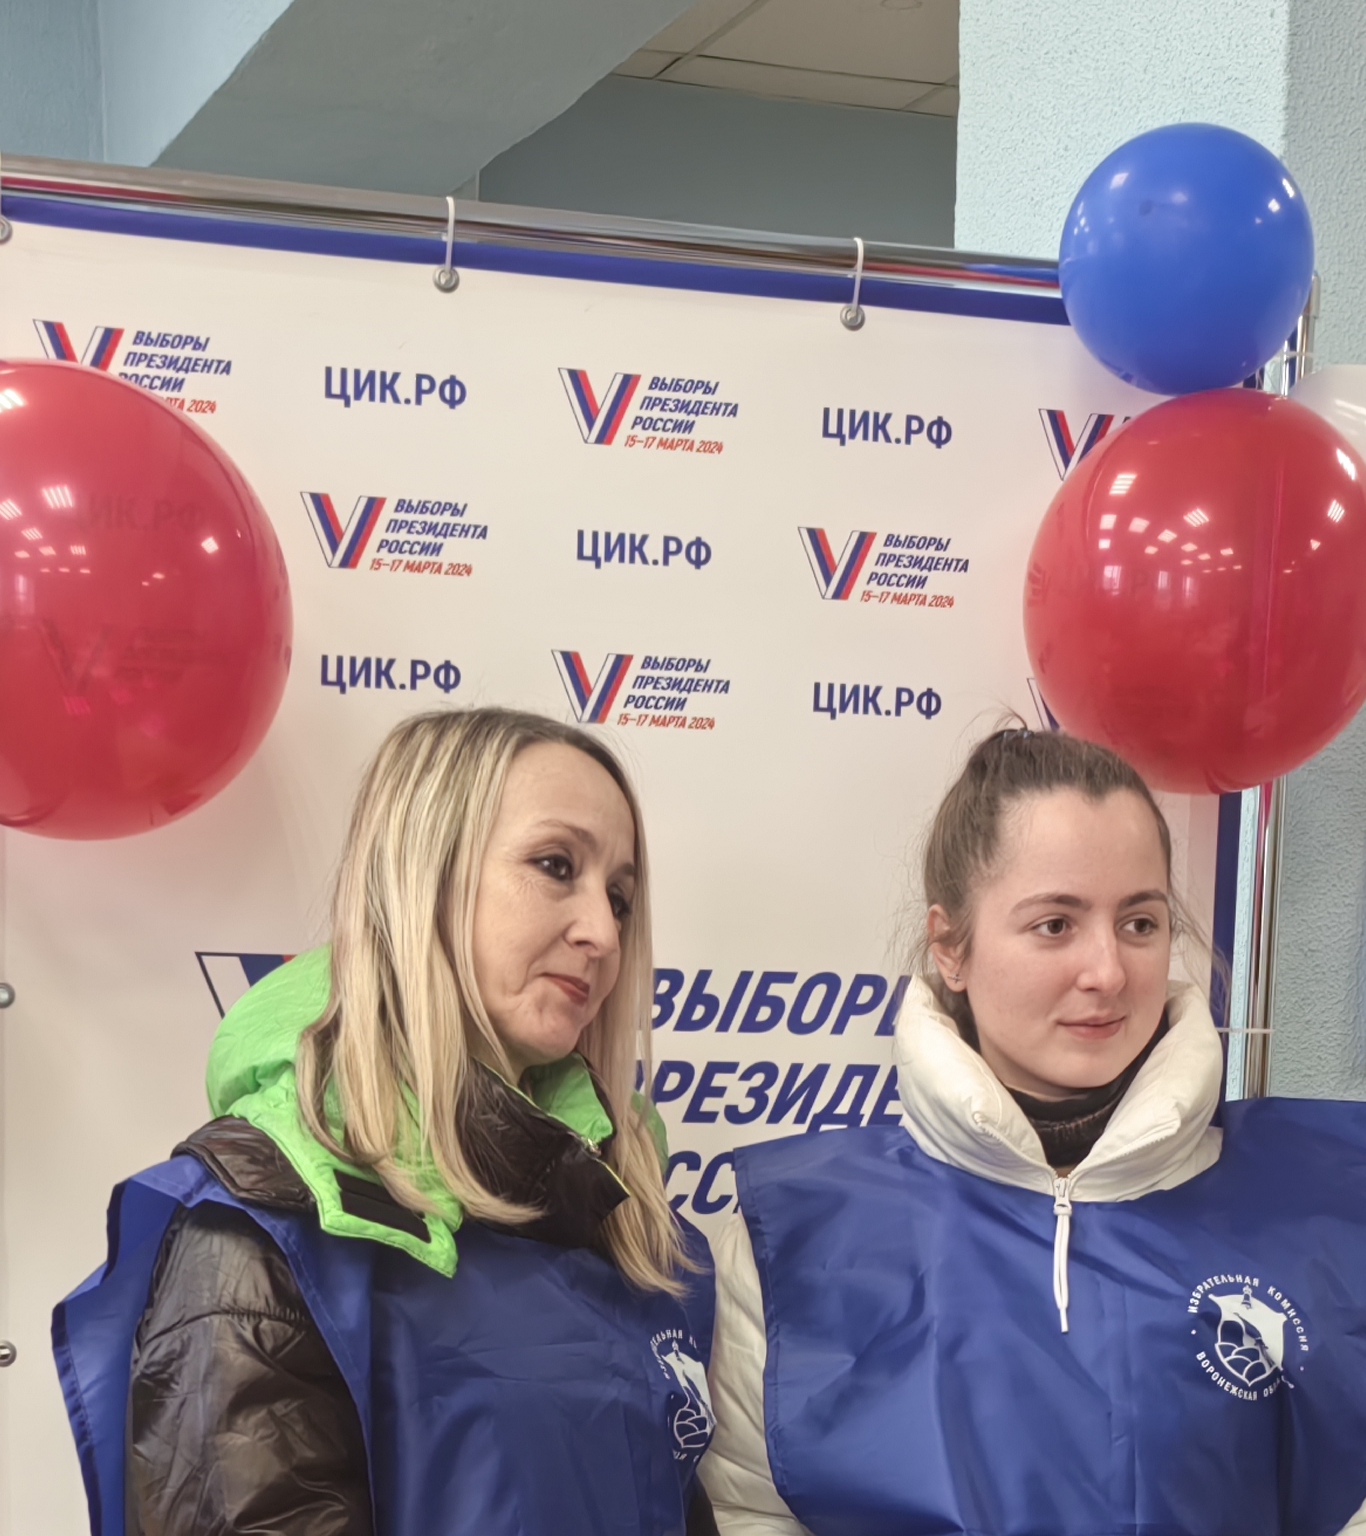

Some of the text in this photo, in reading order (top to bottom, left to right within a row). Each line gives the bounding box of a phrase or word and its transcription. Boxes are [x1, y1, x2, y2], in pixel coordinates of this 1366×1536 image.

[132, 330, 210, 352] ВЫБОРЫ
[123, 351, 232, 376] ПРЕЗИДЕНТА
[324, 366, 467, 409] ЦИК.РФ
[648, 376, 720, 396] ВЫБОРЫ
[187, 399, 217, 414] 2024
[639, 396, 739, 418] ПРЕЗИДЕНТА
[631, 416, 696, 434] РОССИИ
[822, 406, 953, 449] ЦИК.РФ
[657, 437, 695, 452] МАРТА
[696, 440, 724, 454] 2024
[394, 498, 467, 518] ВЫБОРЫ
[385, 518, 488, 540] ПРЕЗИДЕНТА
[376, 539, 444, 557] РОССИИ
[576, 528, 712, 569] ЦИК.РФ
[883, 533, 951, 552] ВЫБОРЫ
[403, 559, 443, 575] МАРТА
[444, 563, 473, 577] 2024
[875, 552, 970, 573] ПРЕЗИДЕНТА
[866, 572, 928, 589] РОССИИ
[890, 592, 927, 607] МАРТА
[928, 595, 955, 608] 2024
[320, 654, 461, 694] ЦИК.РФ
[640, 655, 711, 673] ВЫБОРЫ
[632, 675, 731, 694] ПРЕЗИДЕНТА
[623, 694, 687, 711] РОССИИ
[812, 682, 942, 720] ЦИК.РФ
[649, 714, 687, 729] МАРТА
[688, 717, 715, 730] 2024
[635, 1059, 903, 1133] РЕЗИДЕ
[1267, 1286, 1309, 1352] КОМИССИЯ
[1196, 1351, 1258, 1401] ВОРОНЕЖСКАЯ
